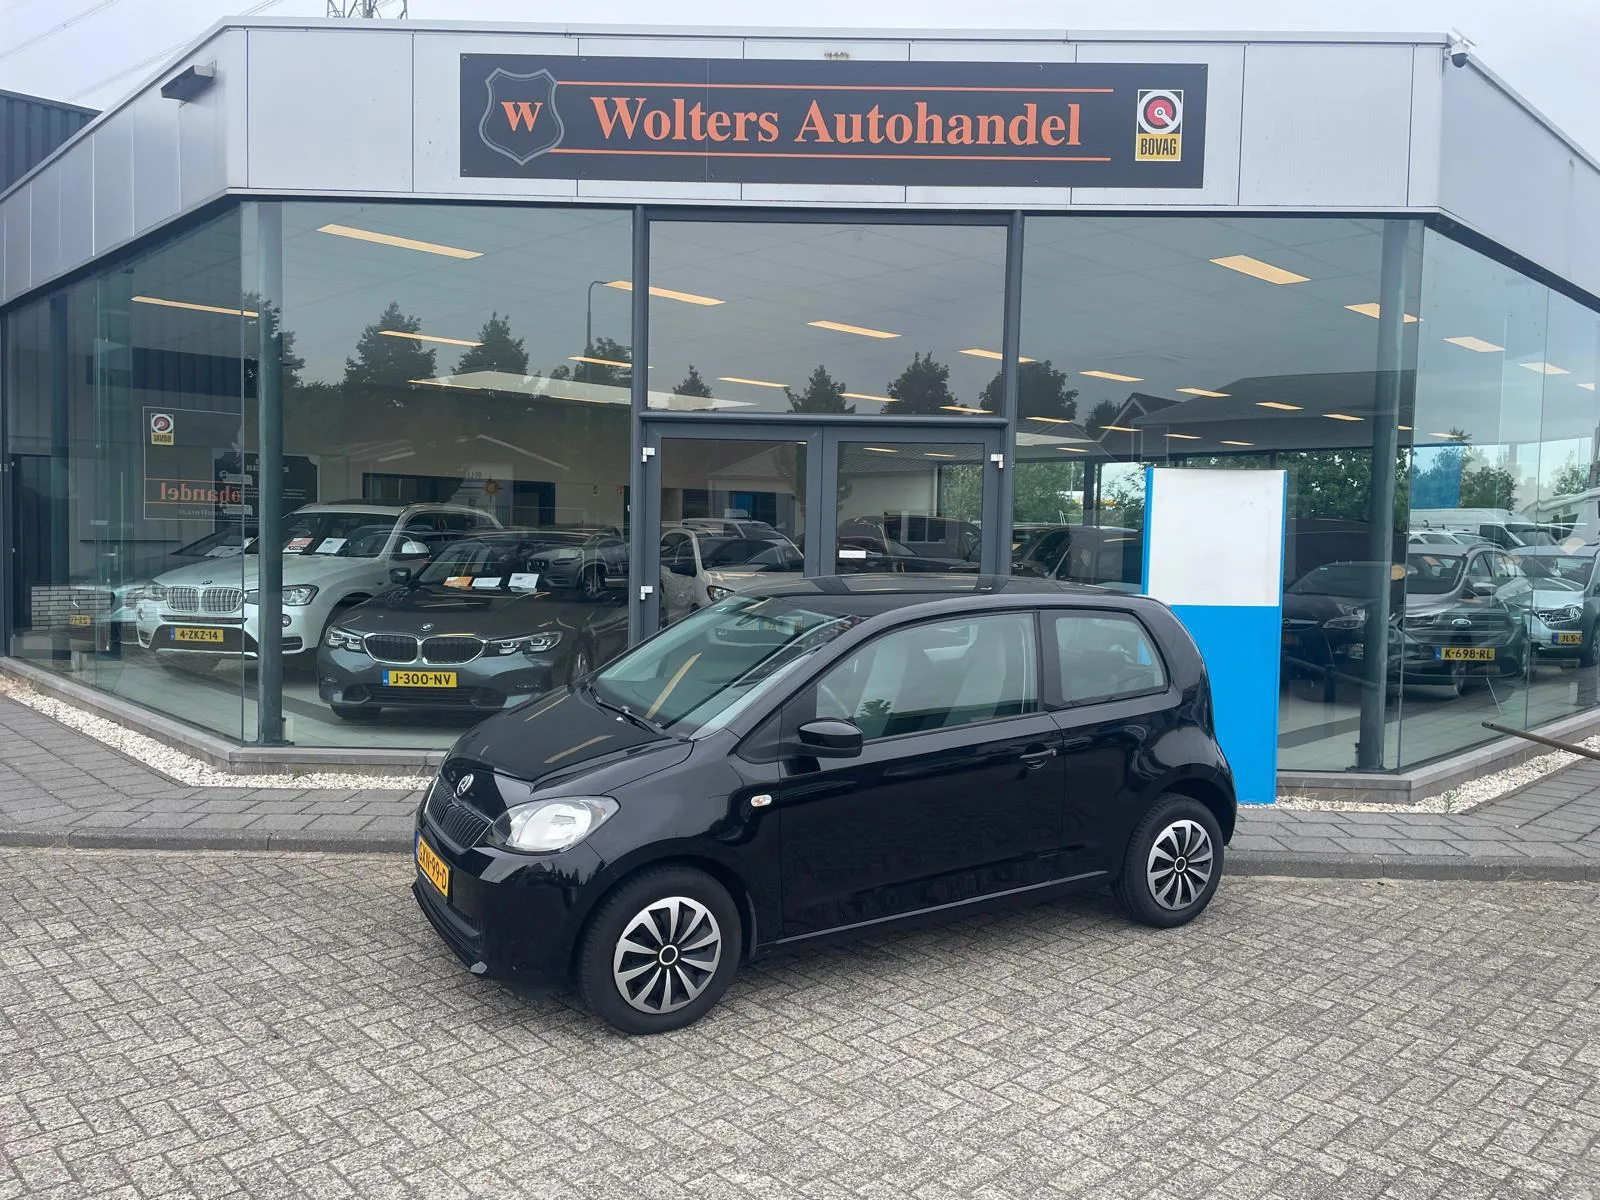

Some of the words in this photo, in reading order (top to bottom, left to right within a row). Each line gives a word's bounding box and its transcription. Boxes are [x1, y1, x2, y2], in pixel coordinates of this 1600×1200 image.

[501, 101, 543, 132] W
[590, 96, 780, 143] Wolters
[794, 99, 1082, 146] Autohandel
[1140, 137, 1178, 157] BOVAG
[179, 629, 218, 640] 4-ZKZ-14
[1444, 648, 1493, 659] K-698-RL
[392, 672, 451, 685] J-300-NV
